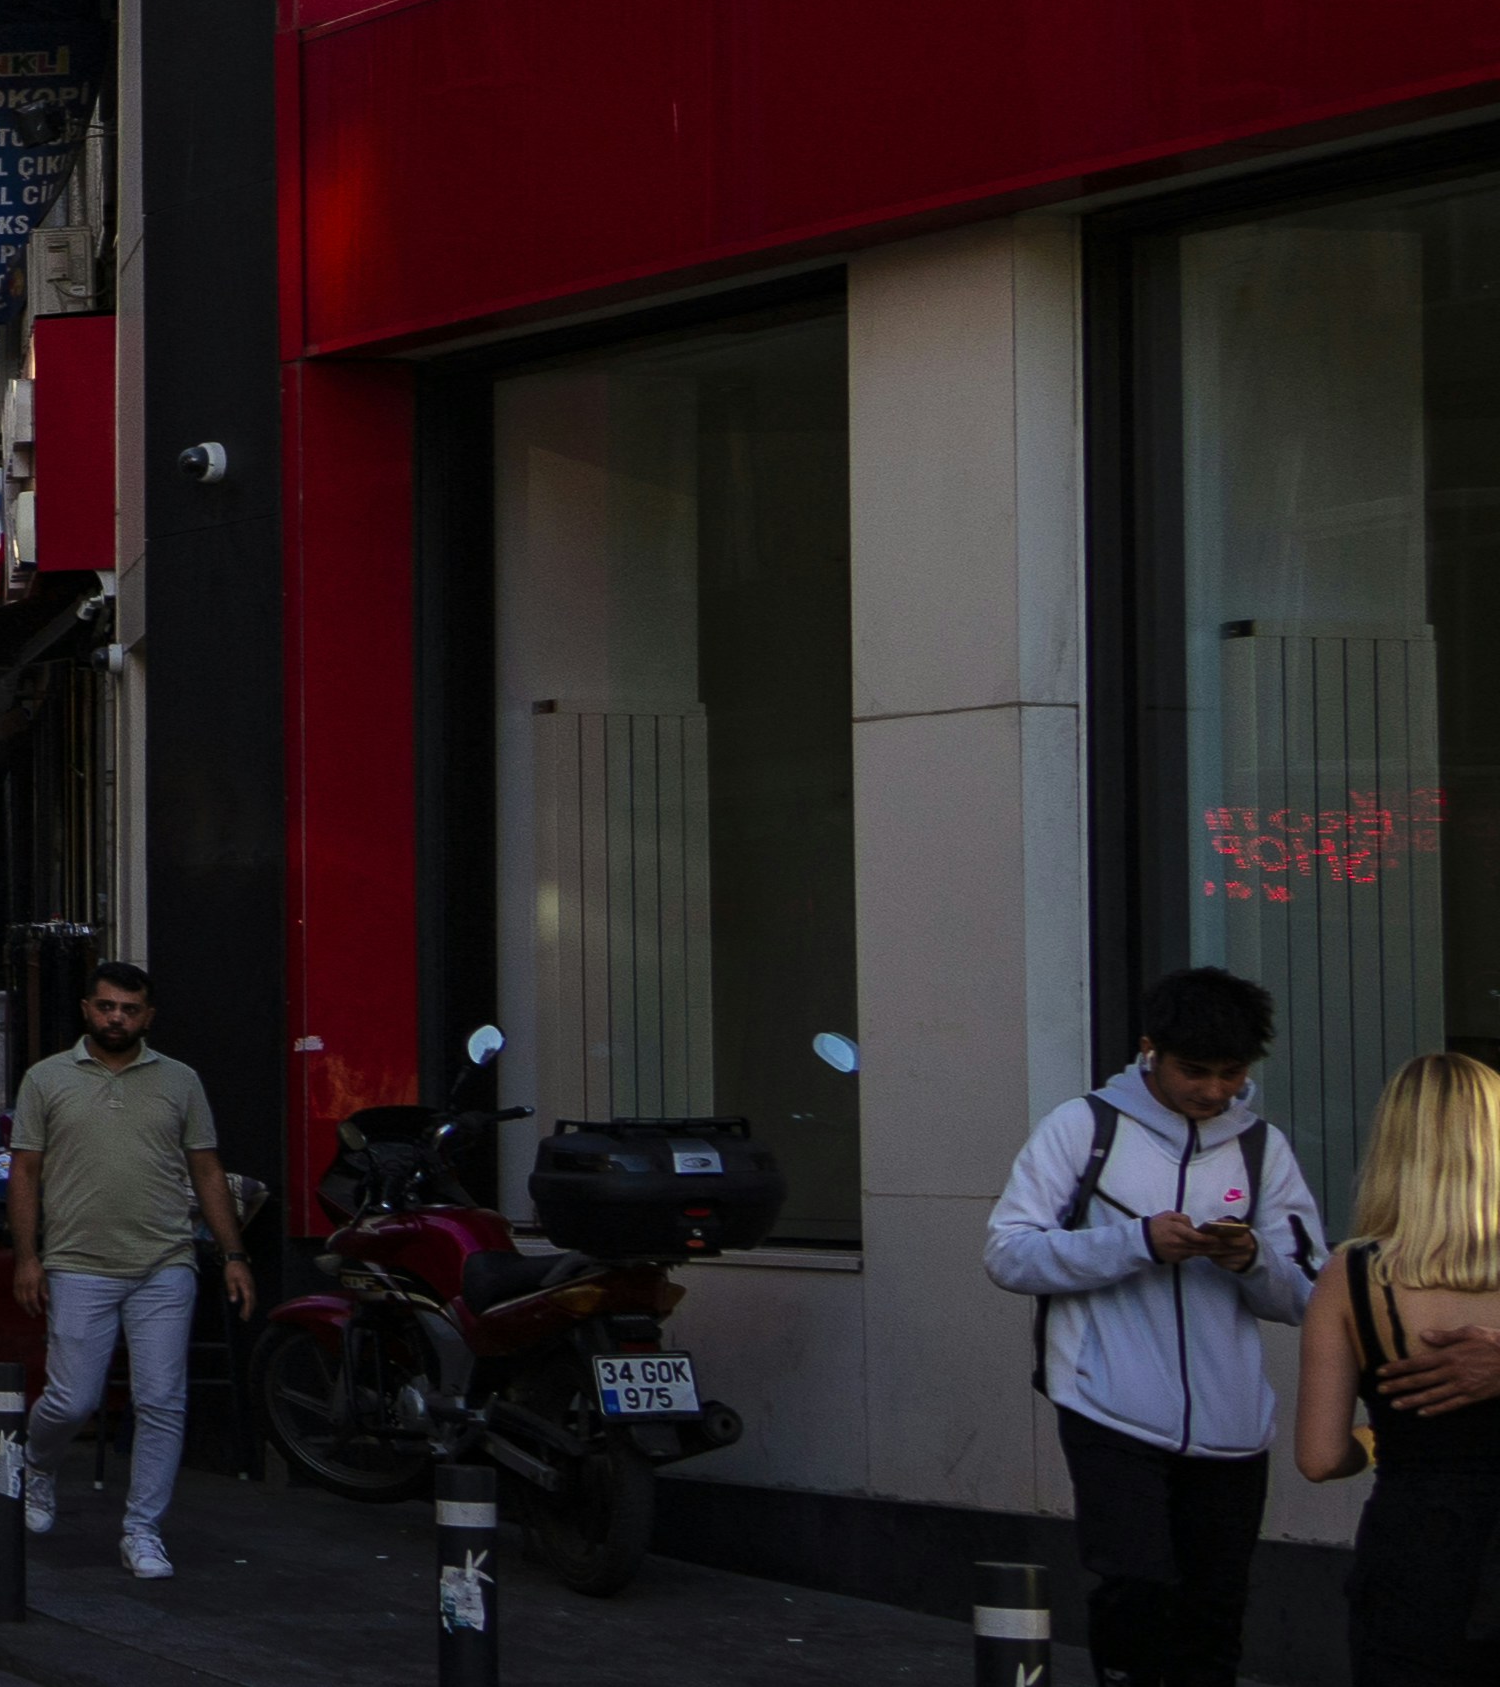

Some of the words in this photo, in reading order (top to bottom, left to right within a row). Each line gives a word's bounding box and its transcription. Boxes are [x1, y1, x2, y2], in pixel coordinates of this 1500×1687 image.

[602, 1361, 634, 1384] 34
[641, 1361, 690, 1384] GOK
[624, 1387, 673, 1409] 975
